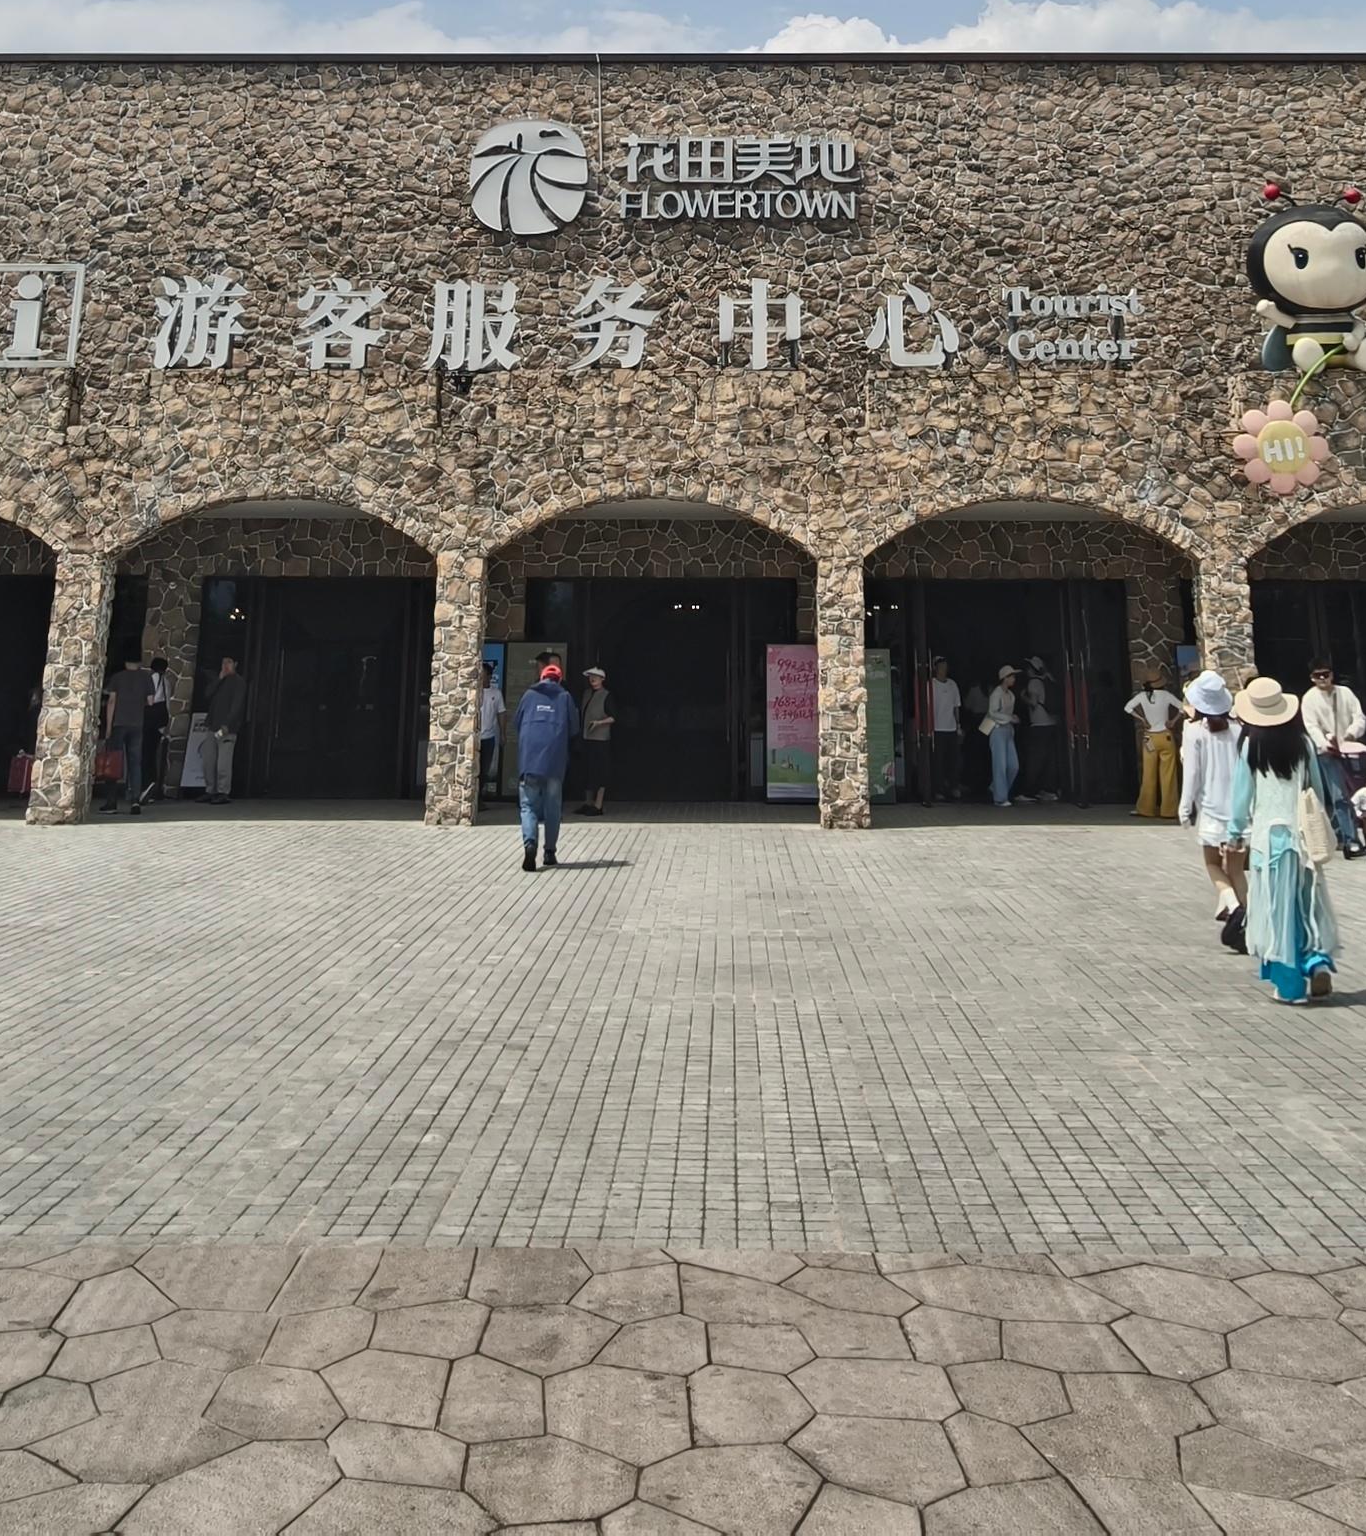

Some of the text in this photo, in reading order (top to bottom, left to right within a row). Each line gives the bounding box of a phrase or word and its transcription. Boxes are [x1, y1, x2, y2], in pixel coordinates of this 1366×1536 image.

[615, 133, 863, 186] 花田美地
[619, 185, 856, 220] FLOWERTOWN
[1002, 283, 1145, 317] Tourist
[153, 273, 960, 372] 游客服务中心
[1008, 330, 1138, 362] Center
[1263, 436, 1305, 463] HI!
